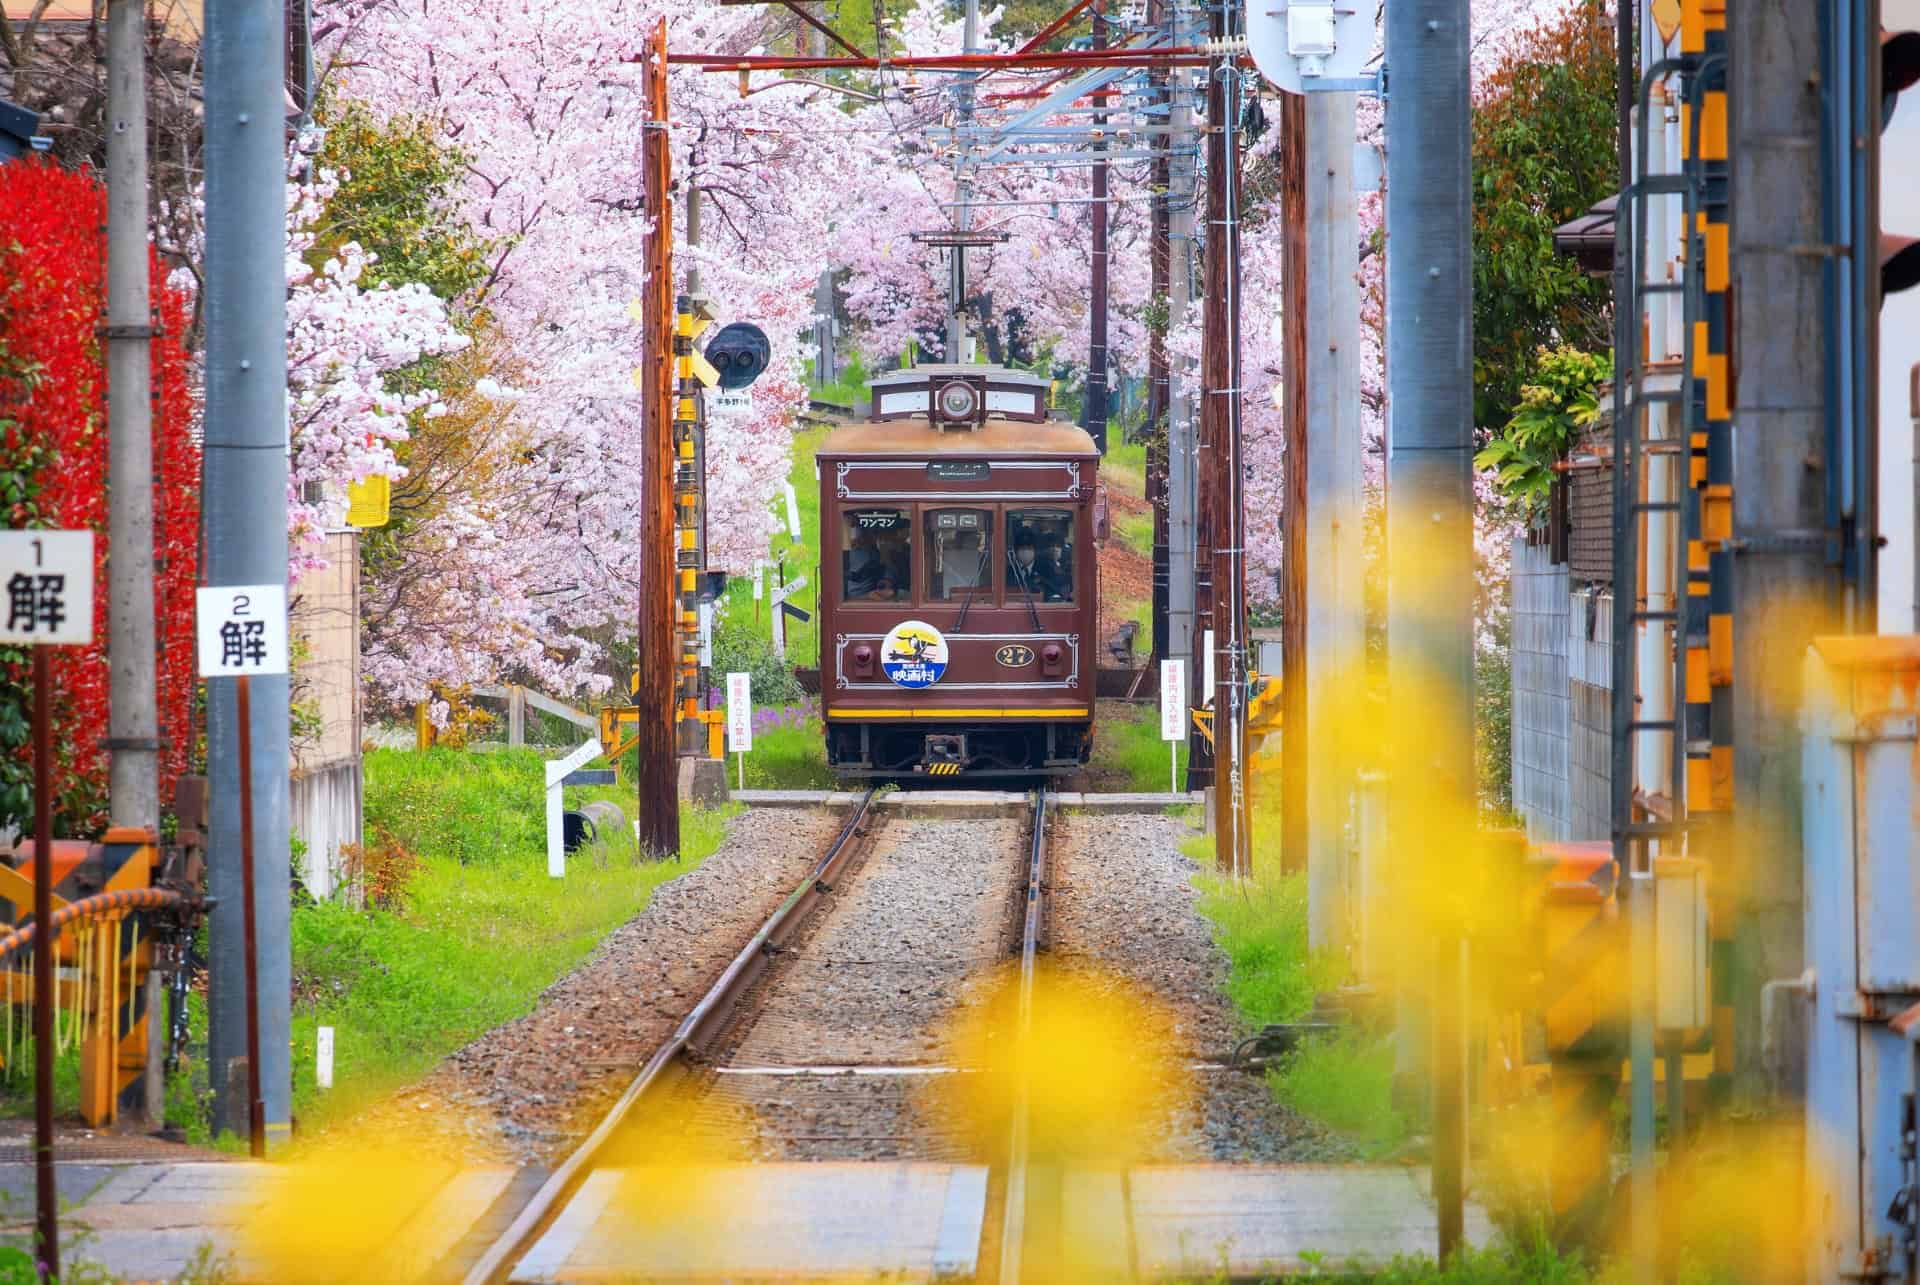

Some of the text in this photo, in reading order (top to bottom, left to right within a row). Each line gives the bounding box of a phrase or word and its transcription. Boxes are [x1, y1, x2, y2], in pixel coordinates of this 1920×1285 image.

[859, 518, 896, 528] ワンマン
[31, 539, 42, 567] 1
[7, 572, 66, 632] 解
[233, 595, 251, 616] 2
[220, 620, 267, 667] 解
[1000, 648, 1025, 664] 27
[892, 669, 935, 682] 映画村
